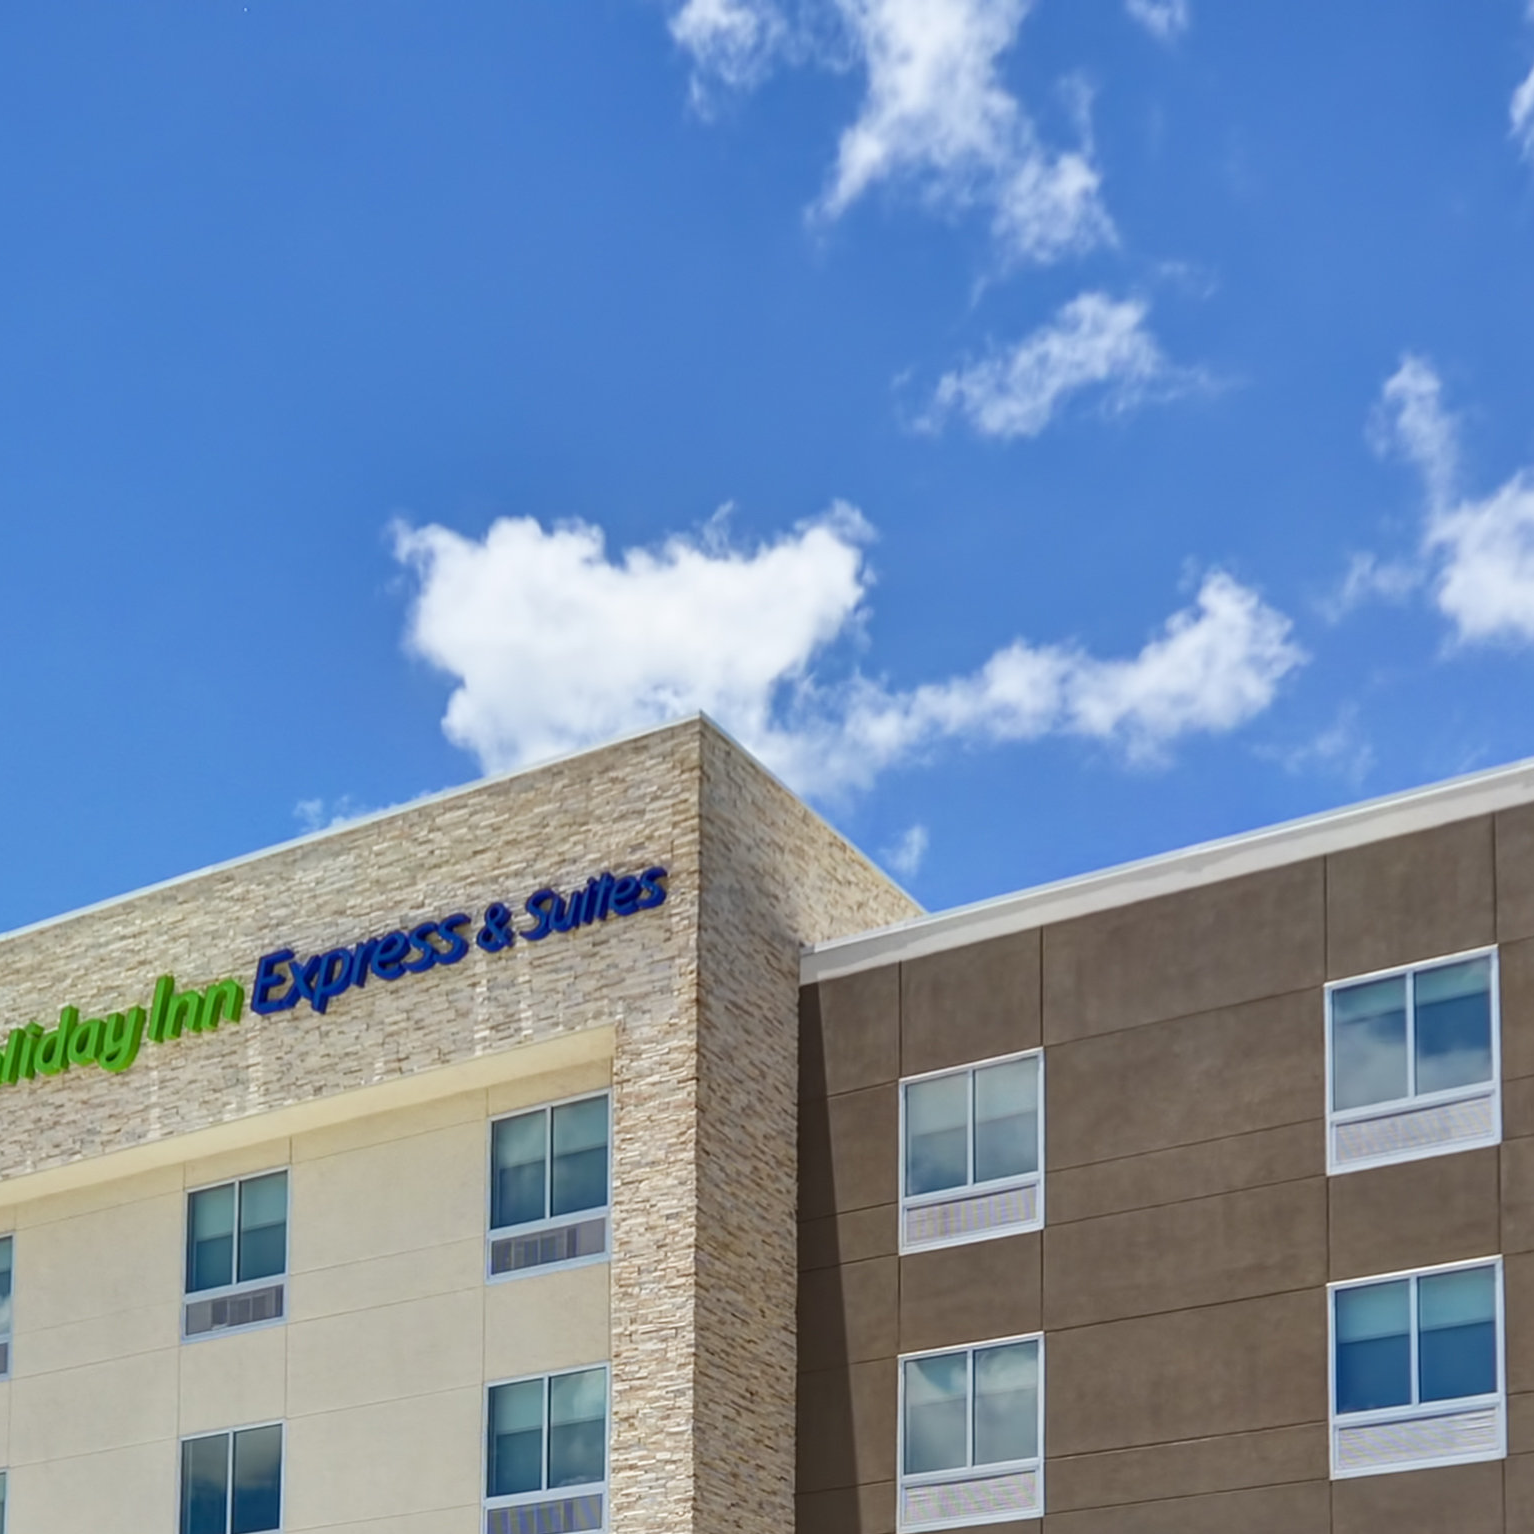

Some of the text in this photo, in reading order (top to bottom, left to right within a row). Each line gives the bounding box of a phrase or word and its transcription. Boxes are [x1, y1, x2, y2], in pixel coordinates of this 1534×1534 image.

[147, 974, 244, 1043] Inn
[250, 913, 471, 1015] Express
[476, 902, 515, 952] &
[520, 866, 667, 941] Suites
